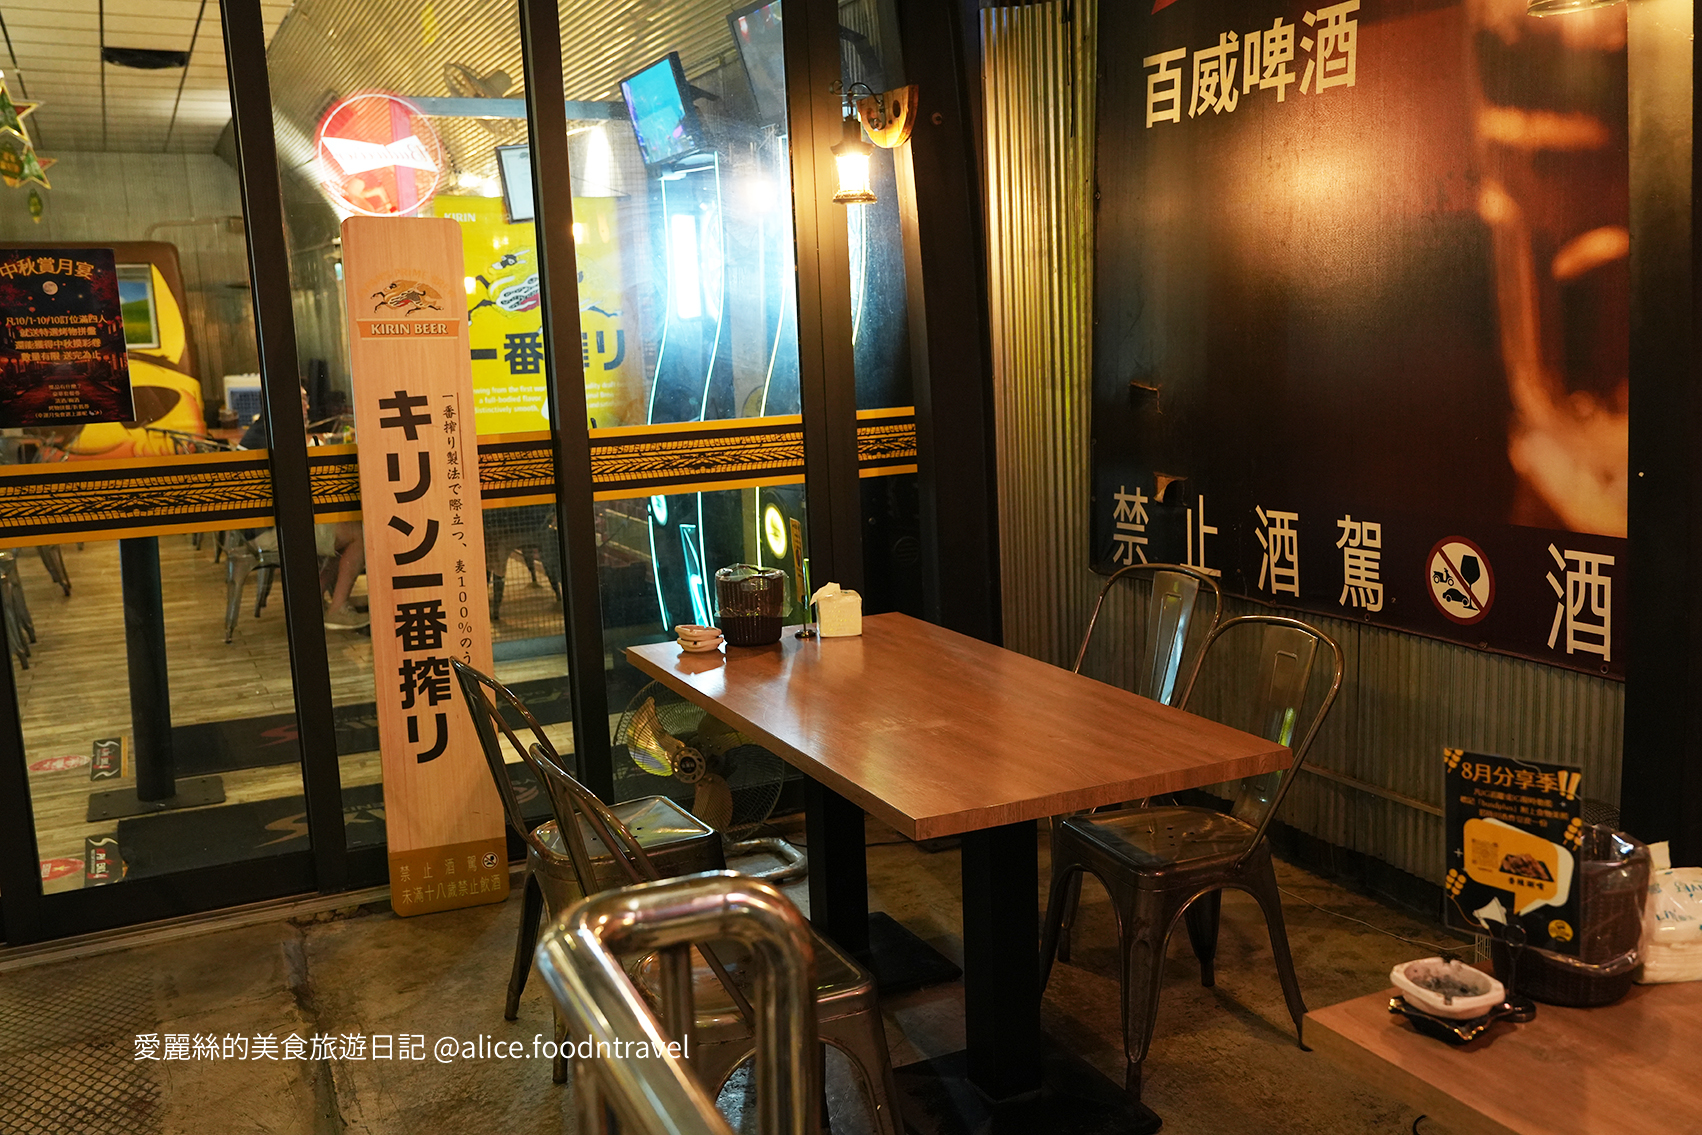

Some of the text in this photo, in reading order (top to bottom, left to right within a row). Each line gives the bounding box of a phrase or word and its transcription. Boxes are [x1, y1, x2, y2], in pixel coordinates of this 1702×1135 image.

[1143, 0, 1360, 128] 百威啤酒
[444, 212, 476, 222] KIRIN
[0, 257, 94, 280] 中秋賞月宴
[370, 323, 448, 336] KIRIN BEER
[378, 390, 452, 764] キリン一番搾り
[1113, 485, 1615, 662] 禁止酒駕 酒
[400, 855, 477, 882] 禁止酒駕
[402, 873, 501, 905] 未滿十八歲禁止飲酒
